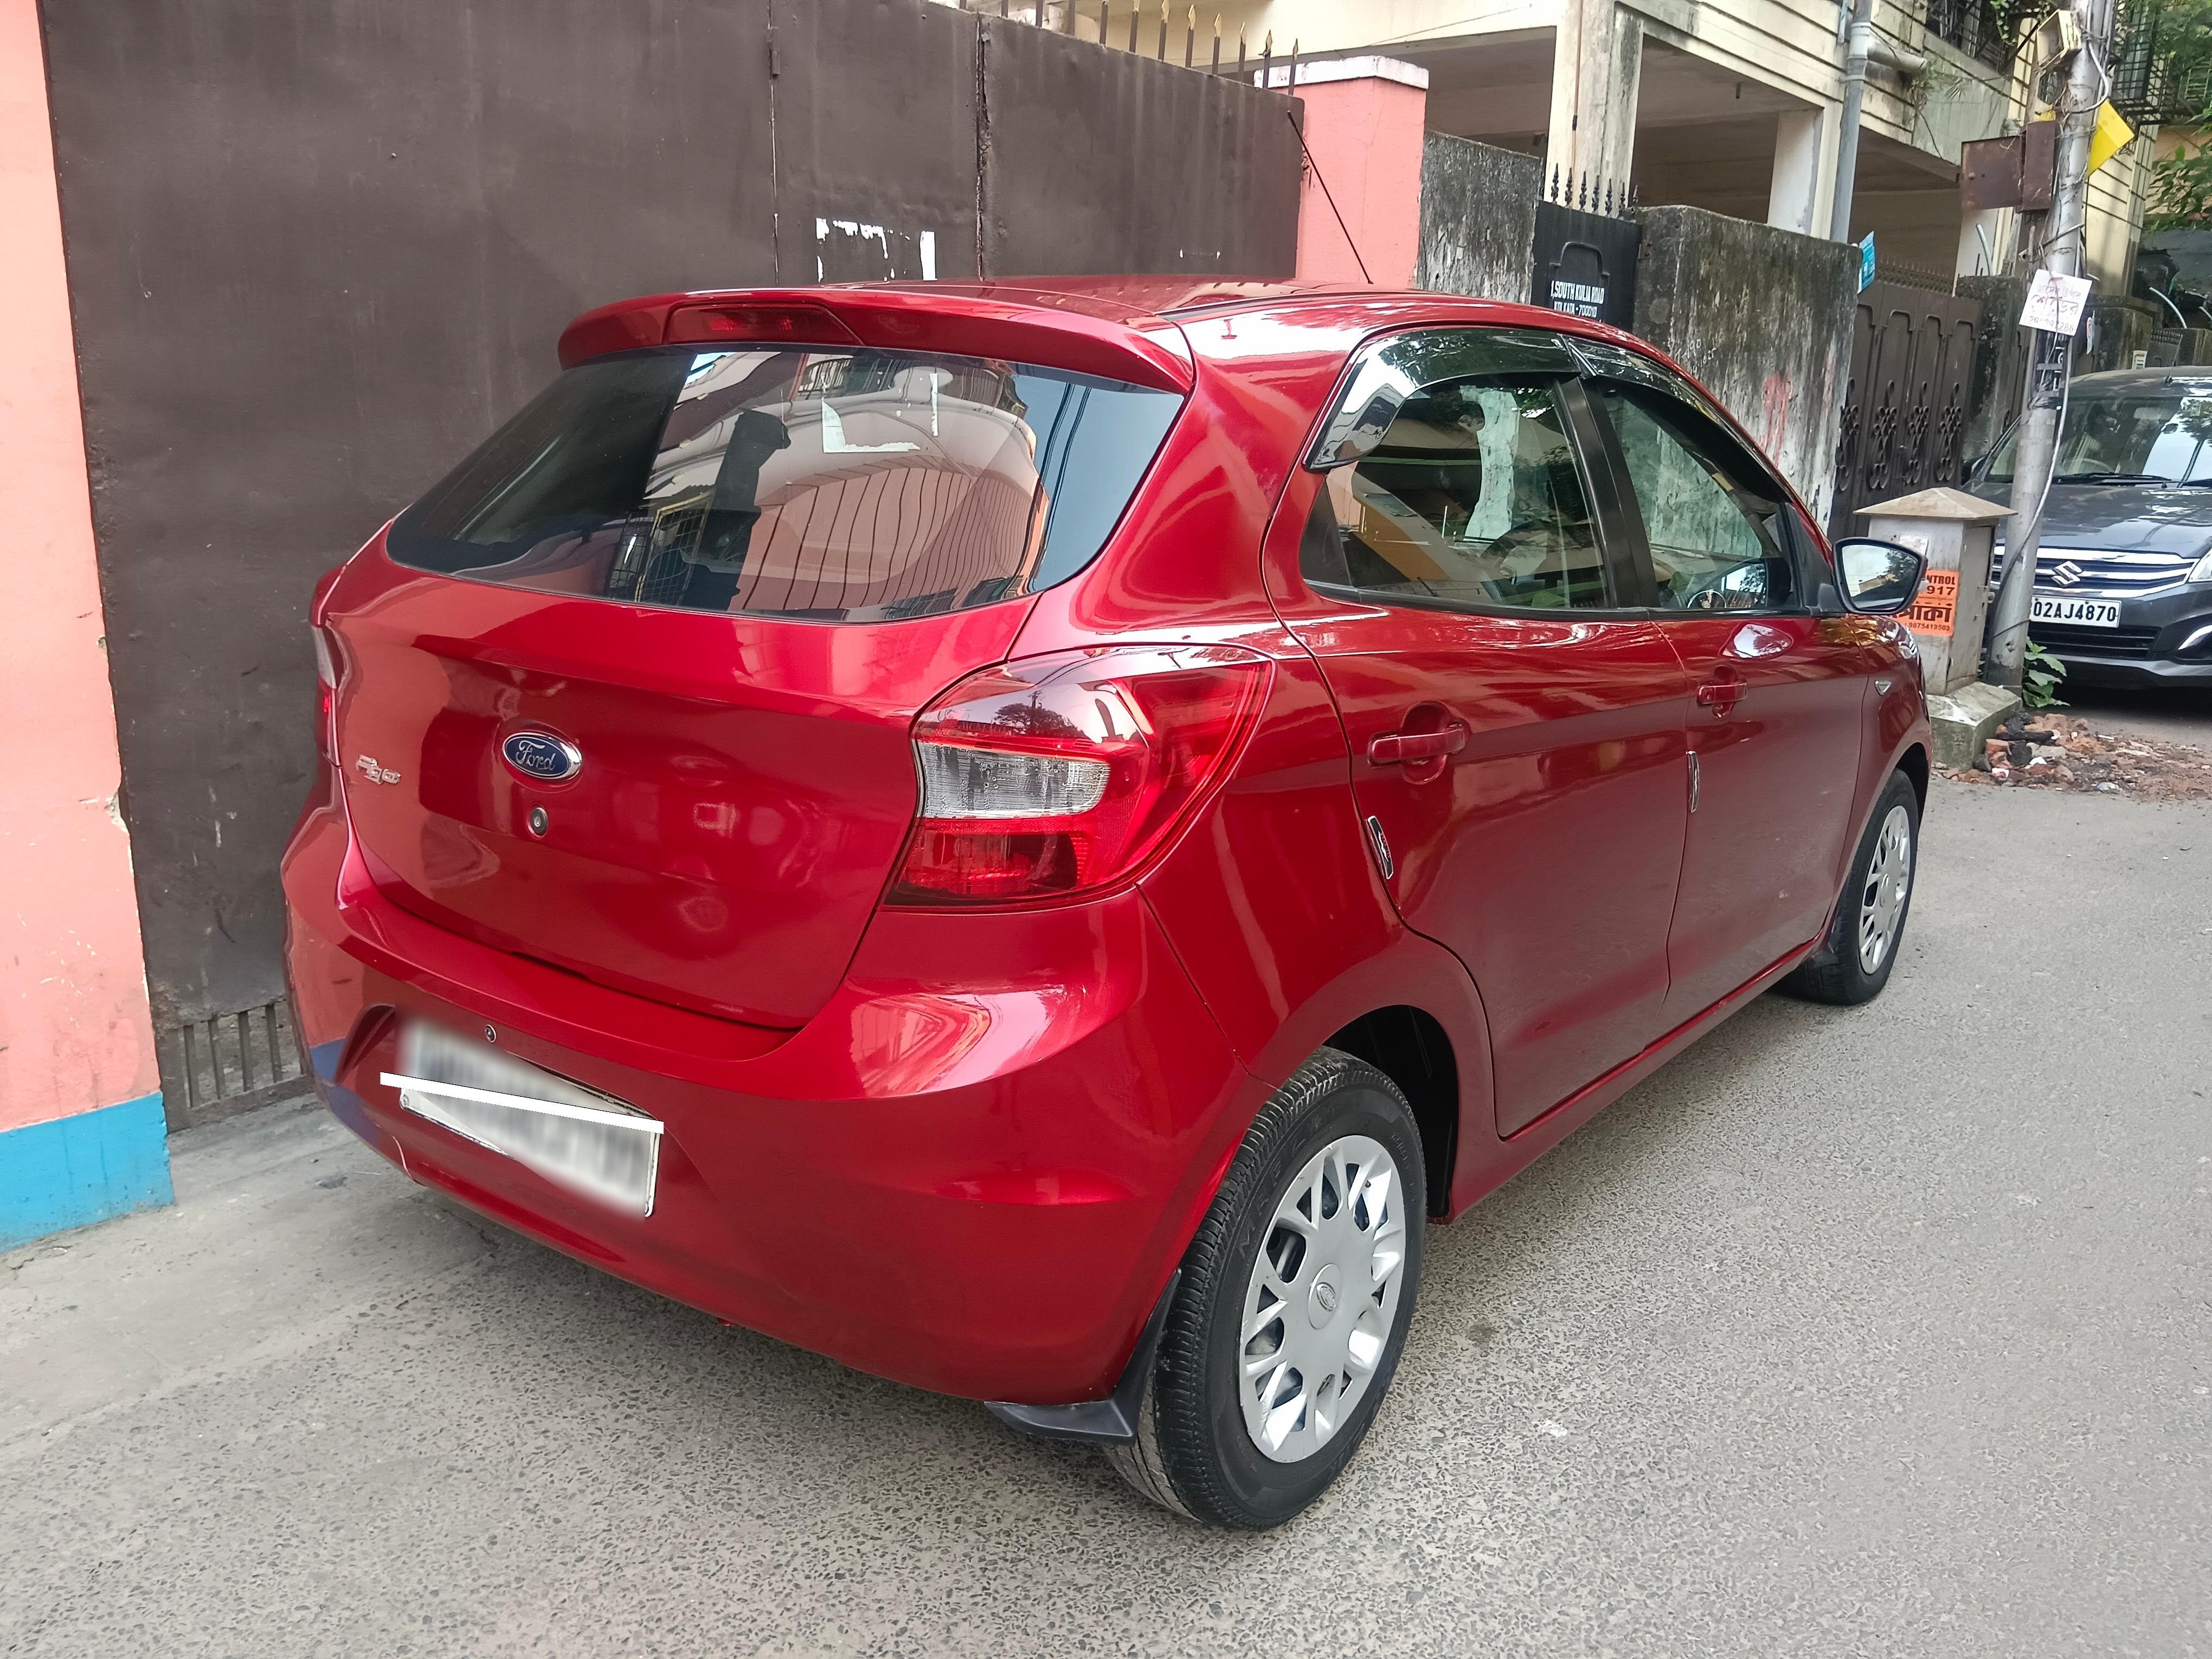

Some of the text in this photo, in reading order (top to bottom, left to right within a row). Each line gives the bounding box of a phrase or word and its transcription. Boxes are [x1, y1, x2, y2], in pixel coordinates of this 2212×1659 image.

[1591, 286, 1605, 304] ROAD
[1926, 575, 1956, 585] NTROL
[1926, 586, 1955, 595] 917
[2034, 601, 2117, 622] 02AJ4870
[516, 740, 556, 771] Ford
